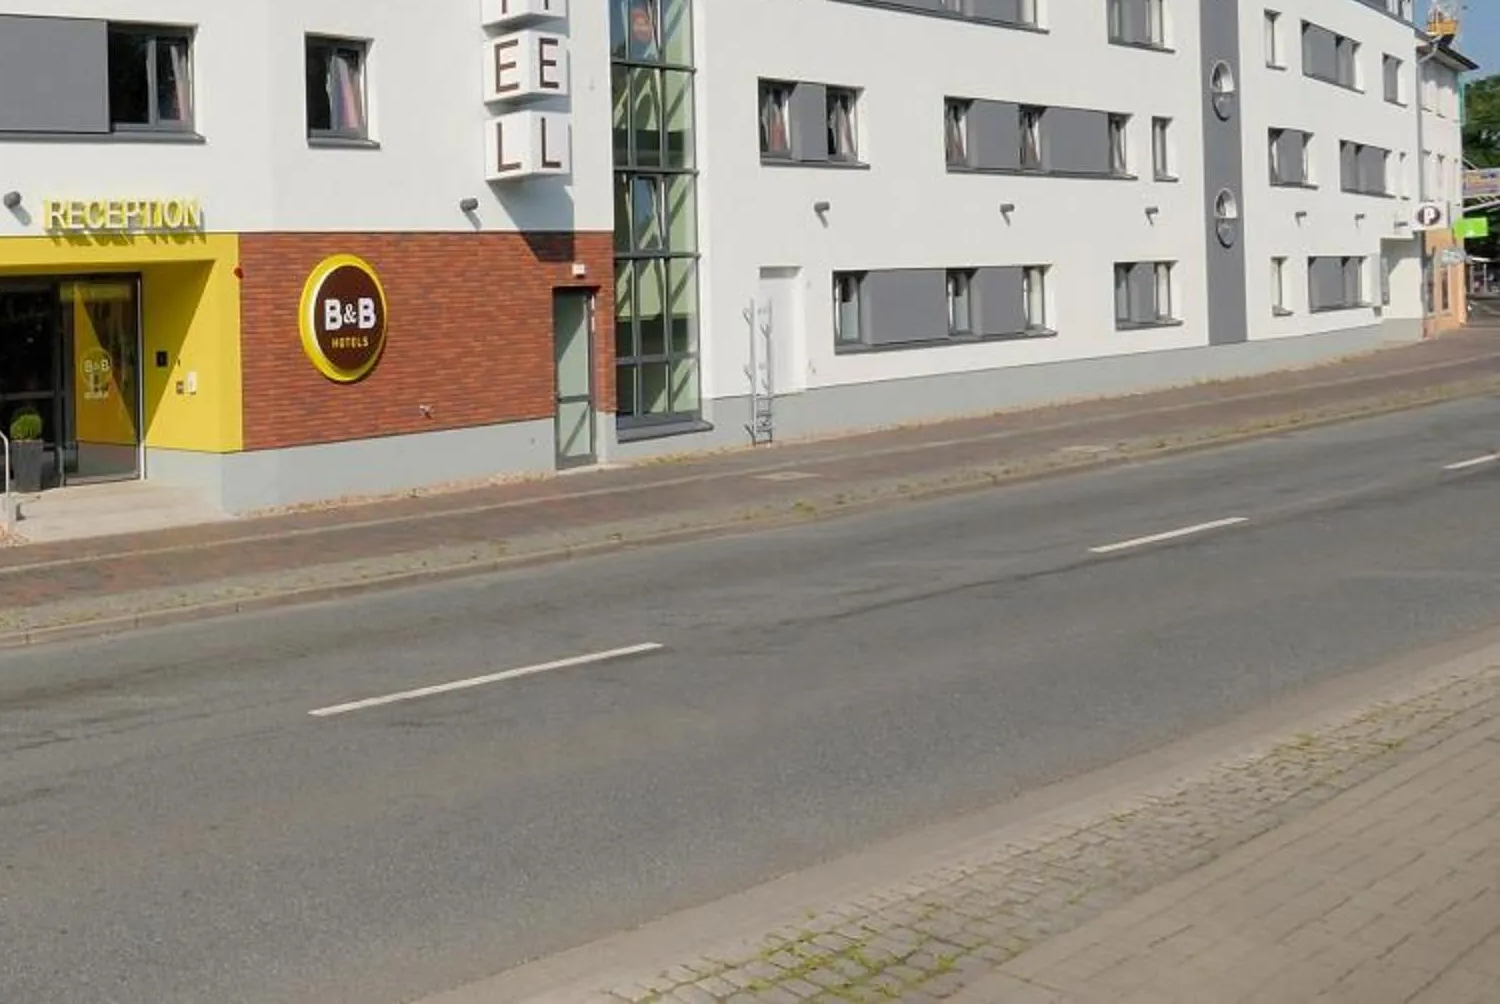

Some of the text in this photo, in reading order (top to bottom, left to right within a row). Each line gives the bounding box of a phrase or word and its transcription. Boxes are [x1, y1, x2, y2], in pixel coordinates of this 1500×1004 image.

[45, 198, 202, 230] RECEPTION
[324, 298, 376, 331] B&B
[331, 337, 369, 349] HOTELS
